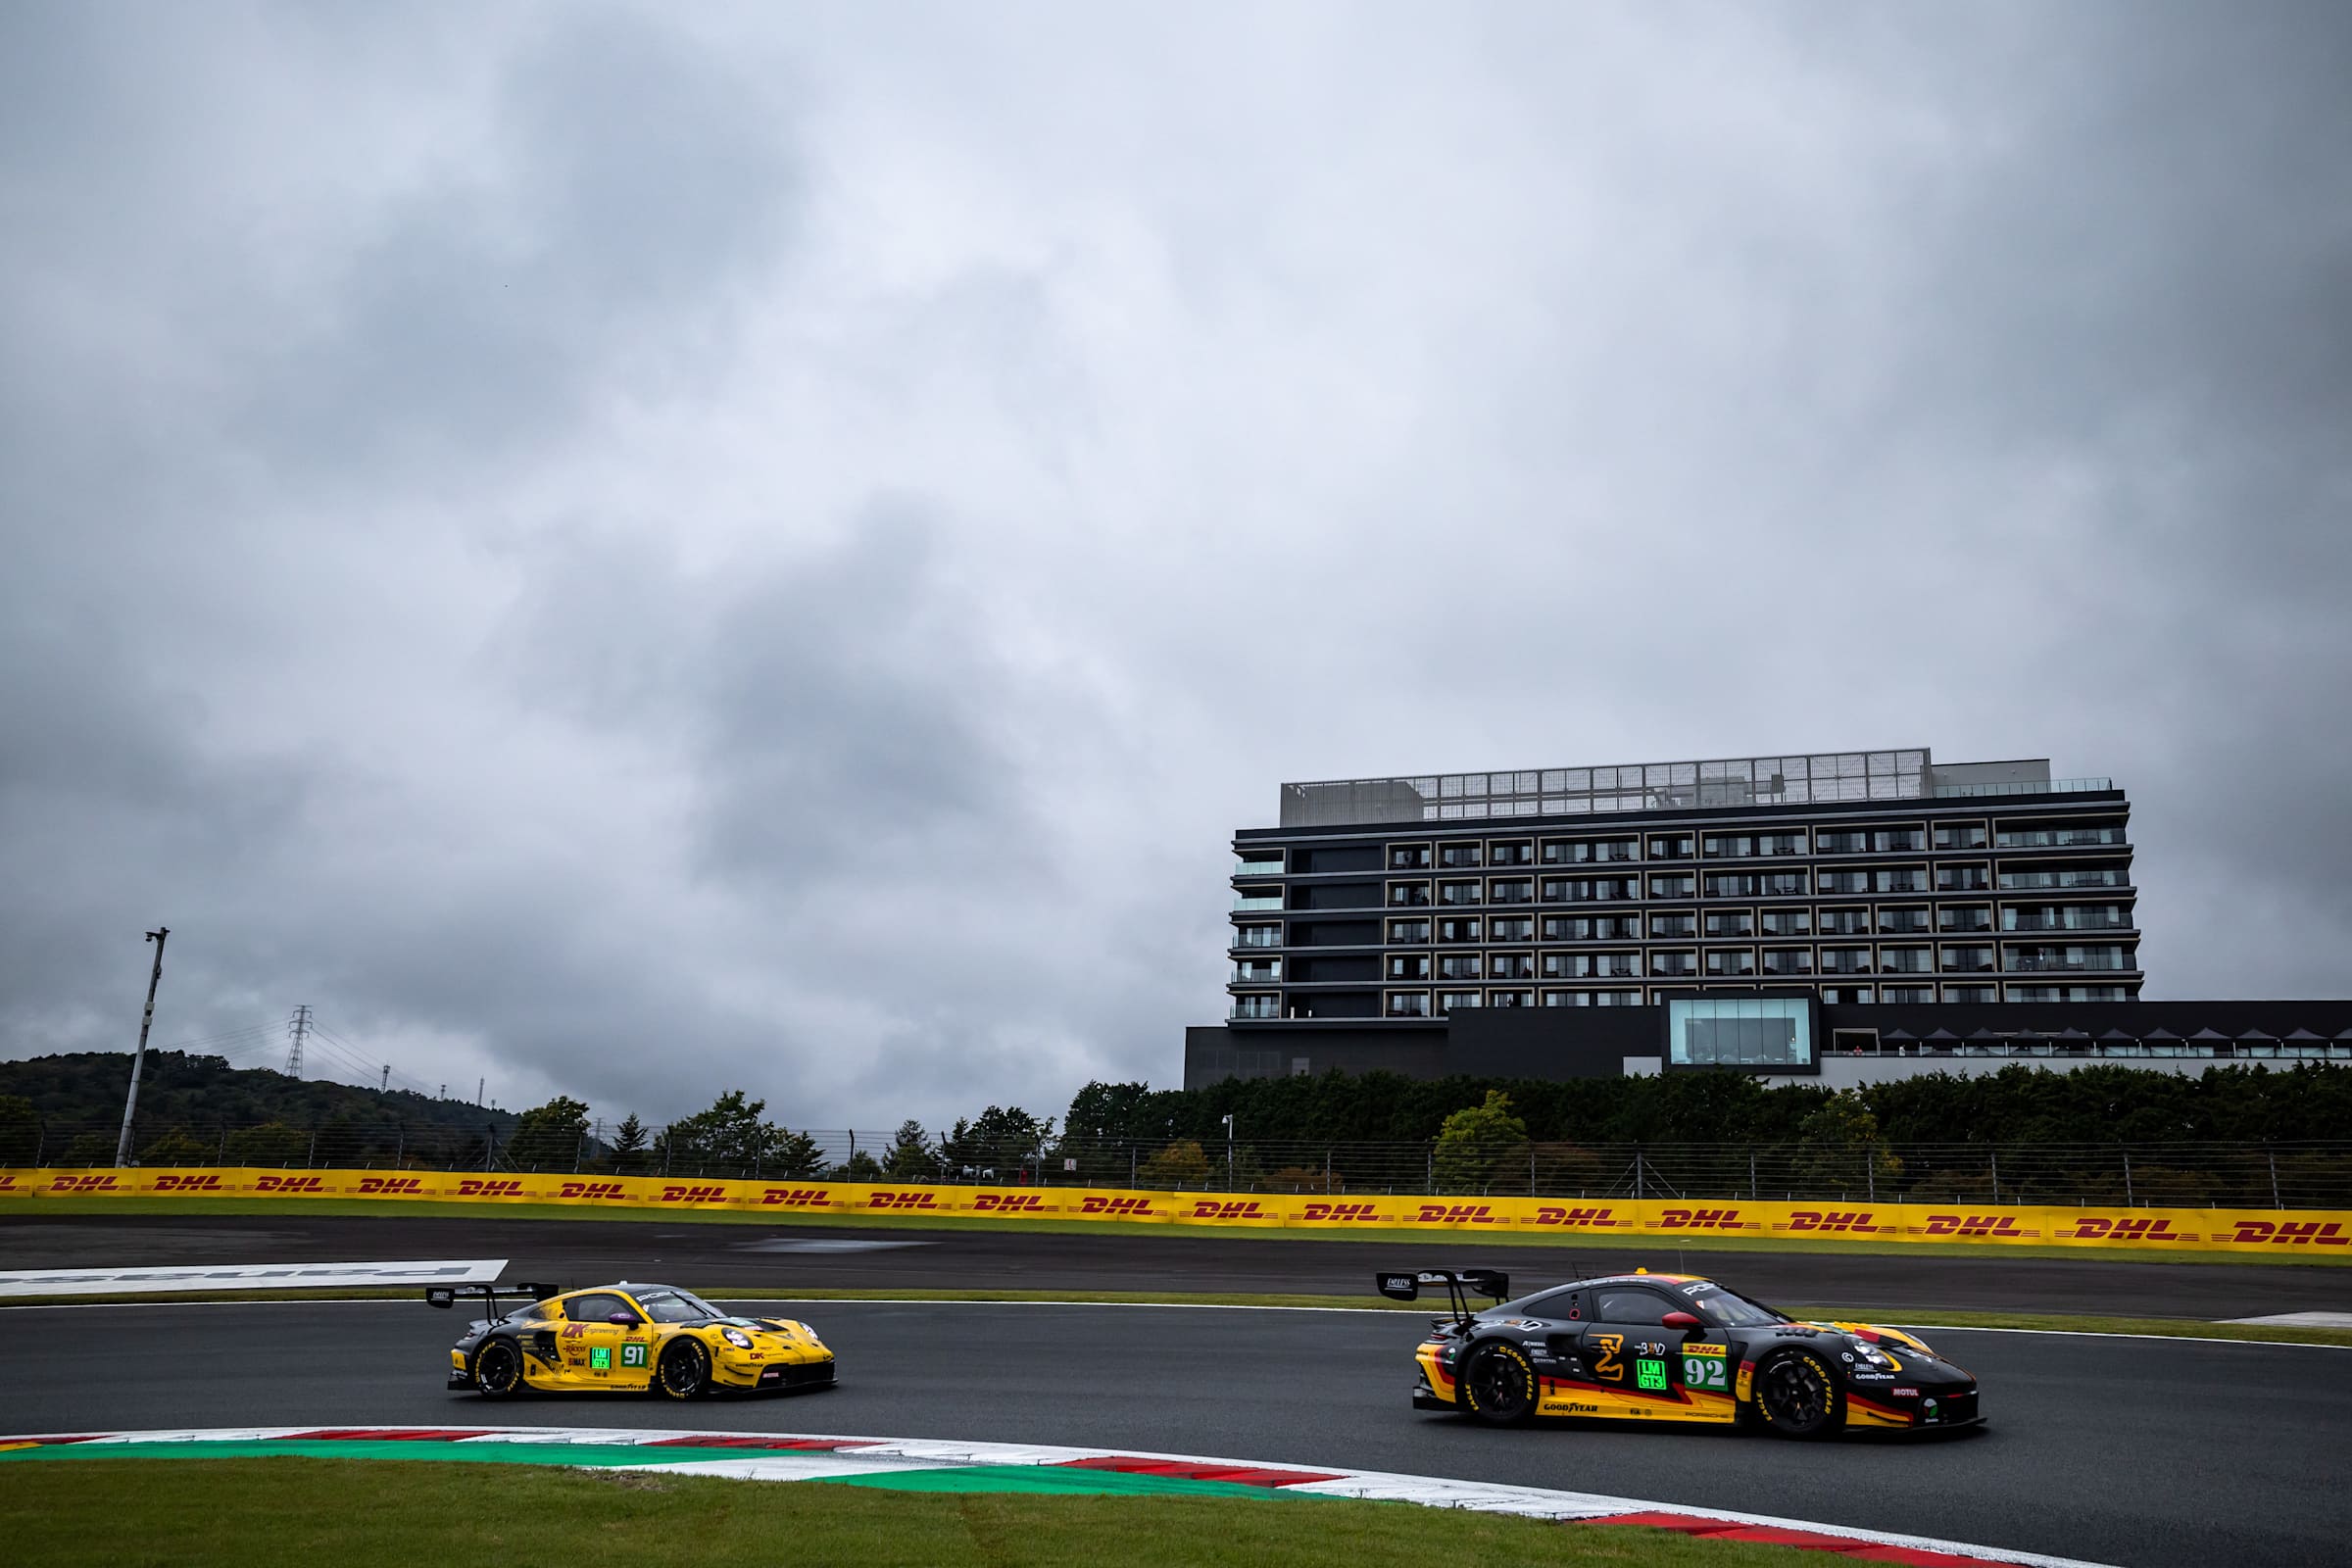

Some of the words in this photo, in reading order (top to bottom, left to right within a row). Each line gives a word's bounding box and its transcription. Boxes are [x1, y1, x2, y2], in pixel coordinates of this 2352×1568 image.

[50, 1177, 118, 1190] DHL
[152, 1176, 222, 1190] DHL
[254, 1177, 323, 1192] DHL
[358, 1179, 422, 1193] DHL
[457, 1181, 523, 1196] DHL
[559, 1184, 625, 1199] DHL
[661, 1187, 726, 1201] DHL
[760, 1190, 831, 1205] DHL
[867, 1194, 937, 1208] DHL
[972, 1196, 1045, 1210] DHL
[1080, 1198, 1153, 1214] DHL
[1193, 1202, 1263, 1217] DHL
[1302, 1204, 1379, 1220] DHL
[1416, 1206, 1494, 1222] DHL
[1535, 1208, 1616, 1225] DHL
[1659, 1210, 1743, 1227] DHL
[1788, 1213, 1878, 1231] DHL
[1925, 1216, 2021, 1236] DHL
[2074, 1219, 2178, 1240] DHL
[2233, 1222, 2350, 1245] DHL
[561, 1323, 588, 1339] DK
[595, 1348, 607, 1359] LM
[624, 1346, 644, 1365] 91
[1688, 1346, 1721, 1354] DHL
[594, 1360, 608, 1369] GT3
[1642, 1361, 1660, 1375] LM
[1685, 1358, 1726, 1387] 92
[1642, 1375, 1663, 1388] GT3
[1802, 1355, 1834, 1415] GOODYEAR
[1893, 1388, 1919, 1396] MOTUL
[1544, 1402, 1598, 1413] GOODYEAR
